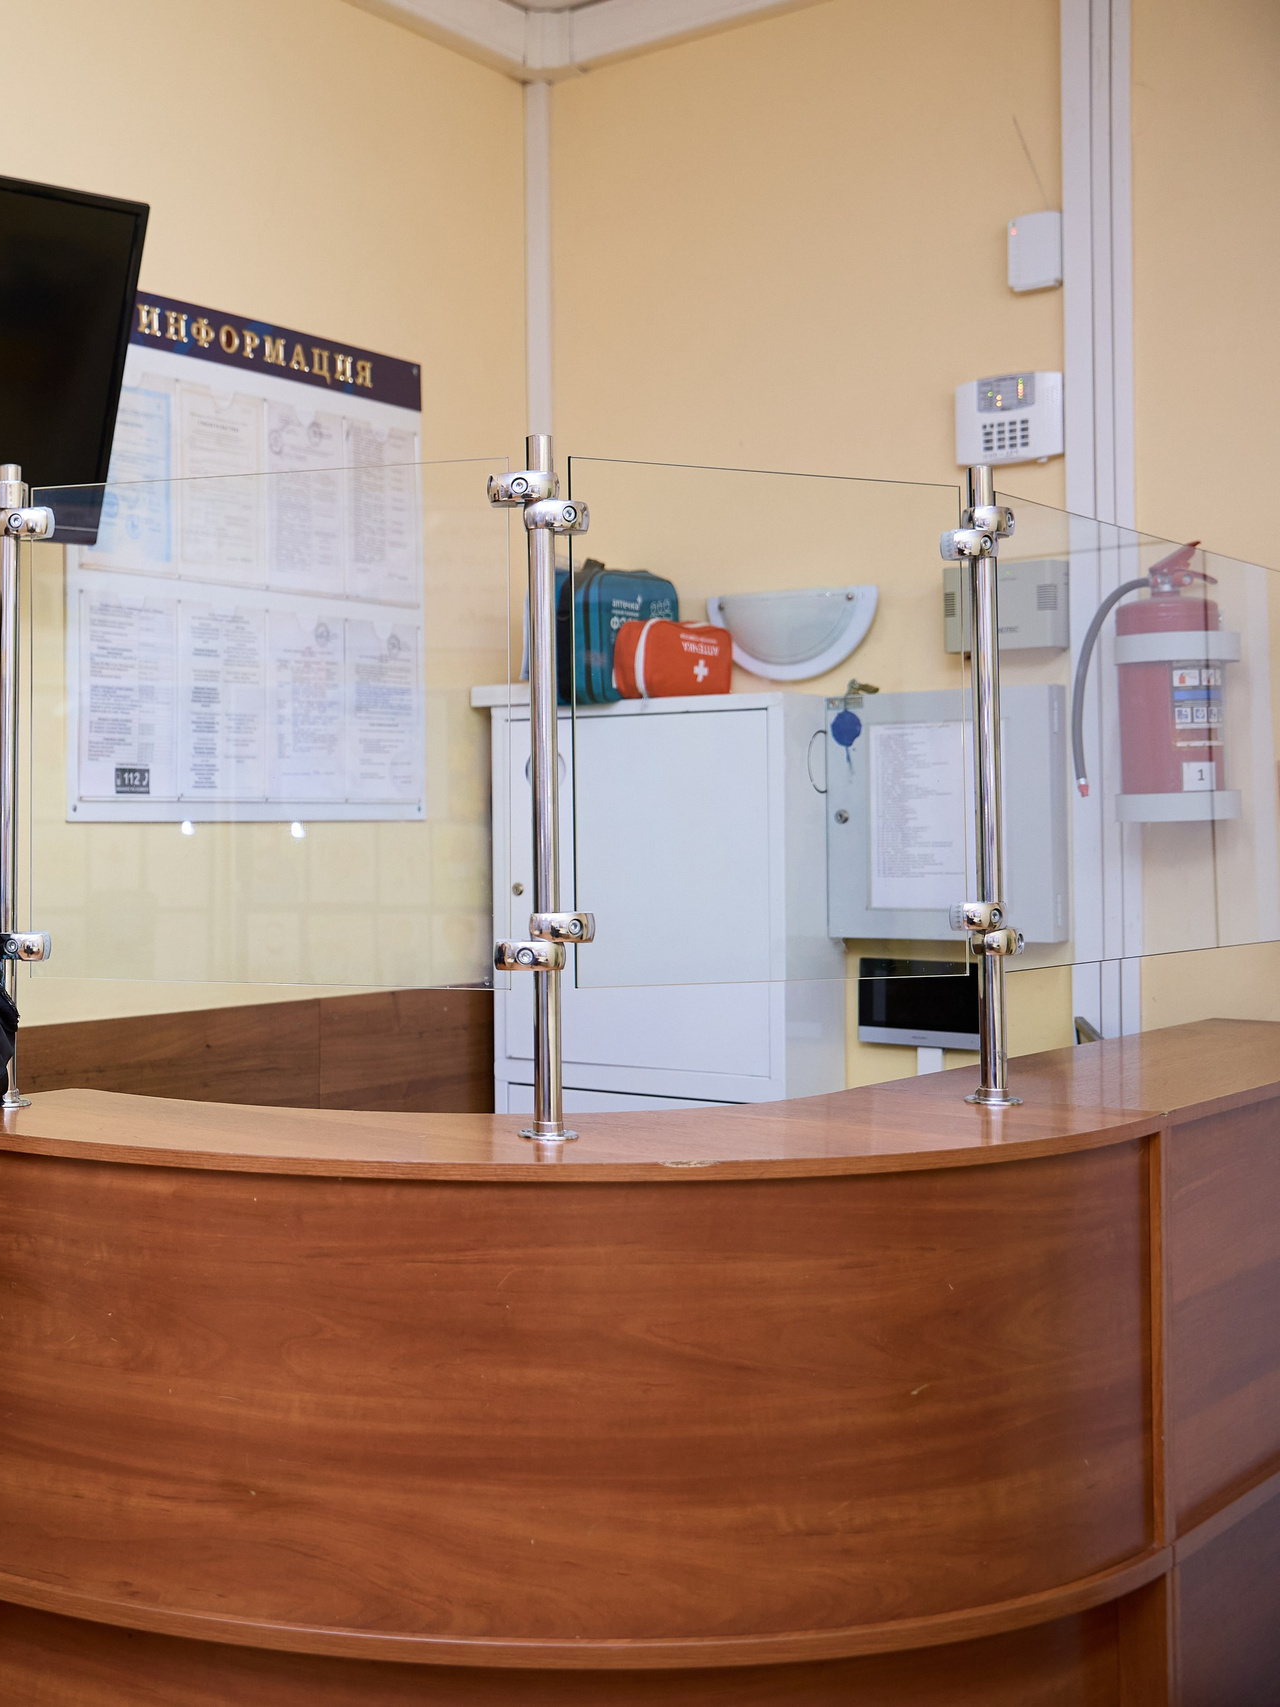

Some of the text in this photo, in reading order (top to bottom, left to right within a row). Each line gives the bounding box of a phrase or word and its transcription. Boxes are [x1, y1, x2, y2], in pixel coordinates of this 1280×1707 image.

[136, 304, 373, 388] ИНФОРМАЦИЯ
[123, 772, 140, 785] 112
[1198, 769, 1205, 781] 1
